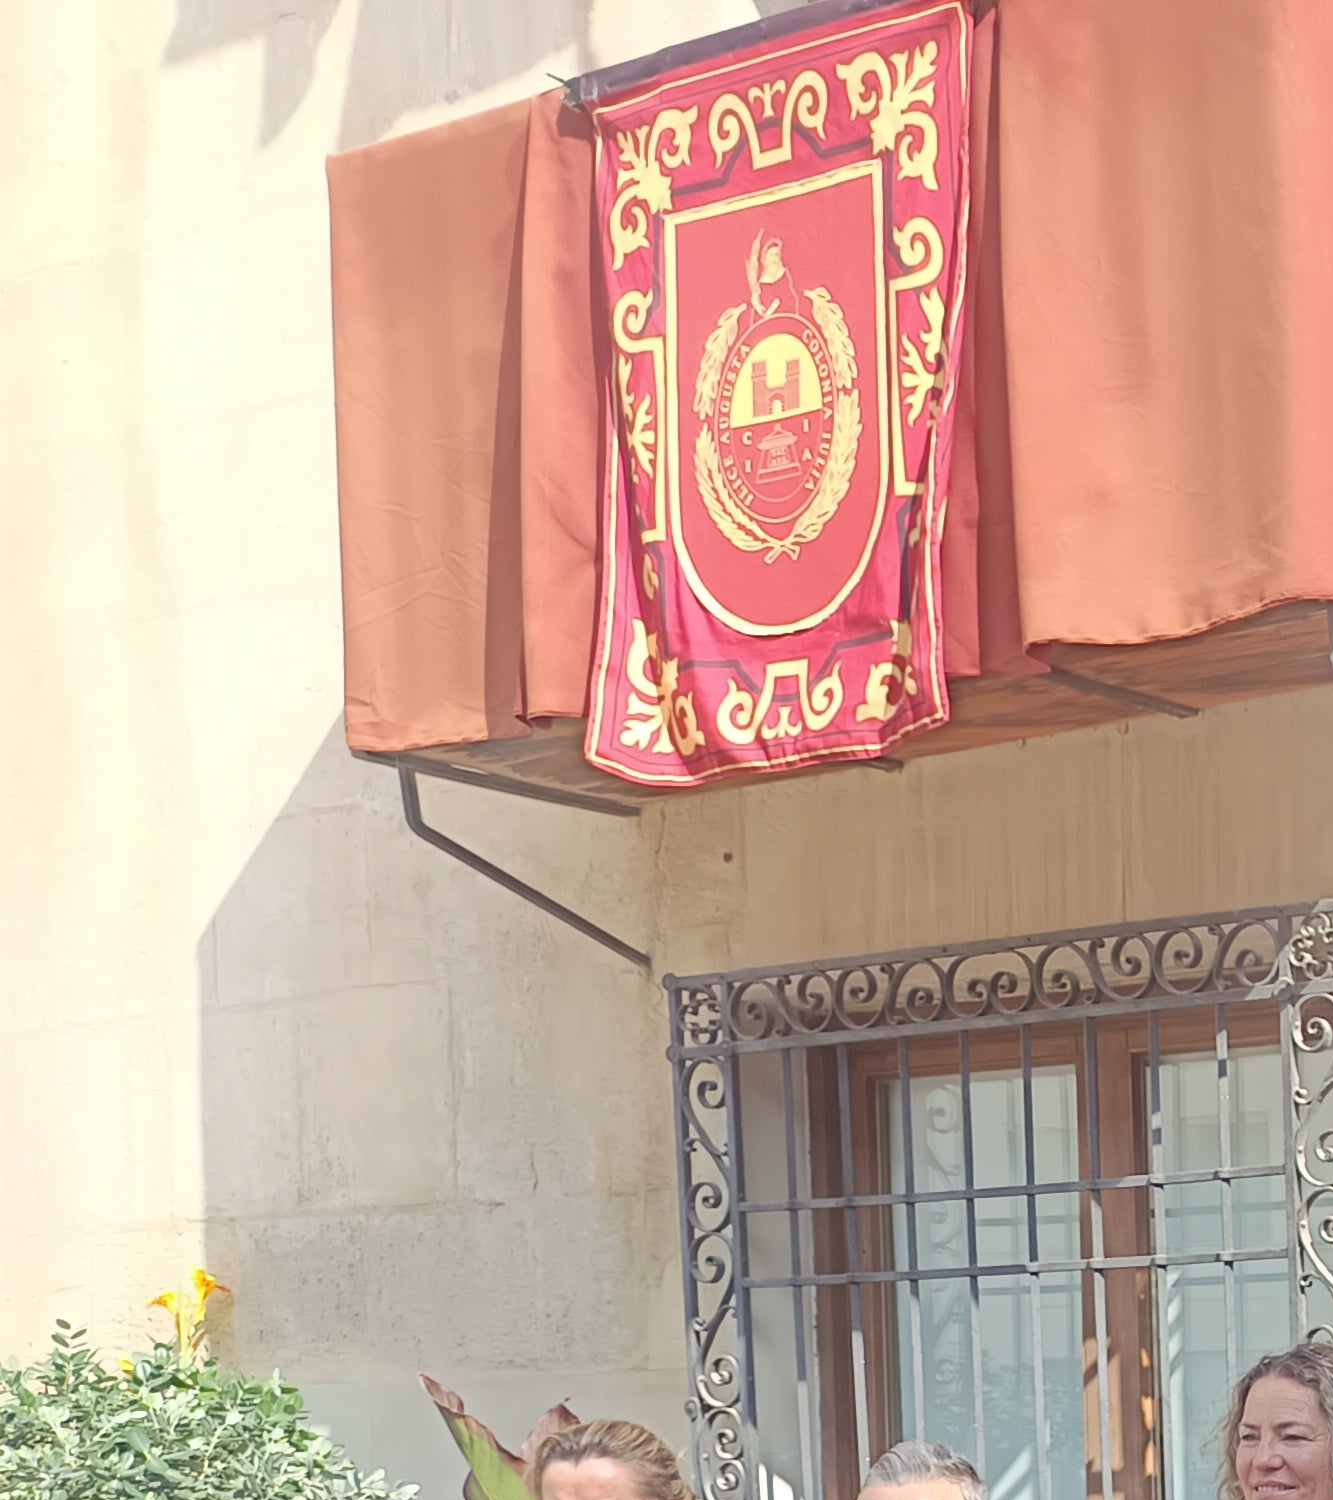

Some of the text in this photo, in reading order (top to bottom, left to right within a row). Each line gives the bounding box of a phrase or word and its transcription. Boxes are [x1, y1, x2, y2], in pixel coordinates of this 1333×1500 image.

[719, 344, 750, 444] AUGUSTA
[802, 328, 833, 420] COLONIA
[804, 432, 832, 491] IULIA
